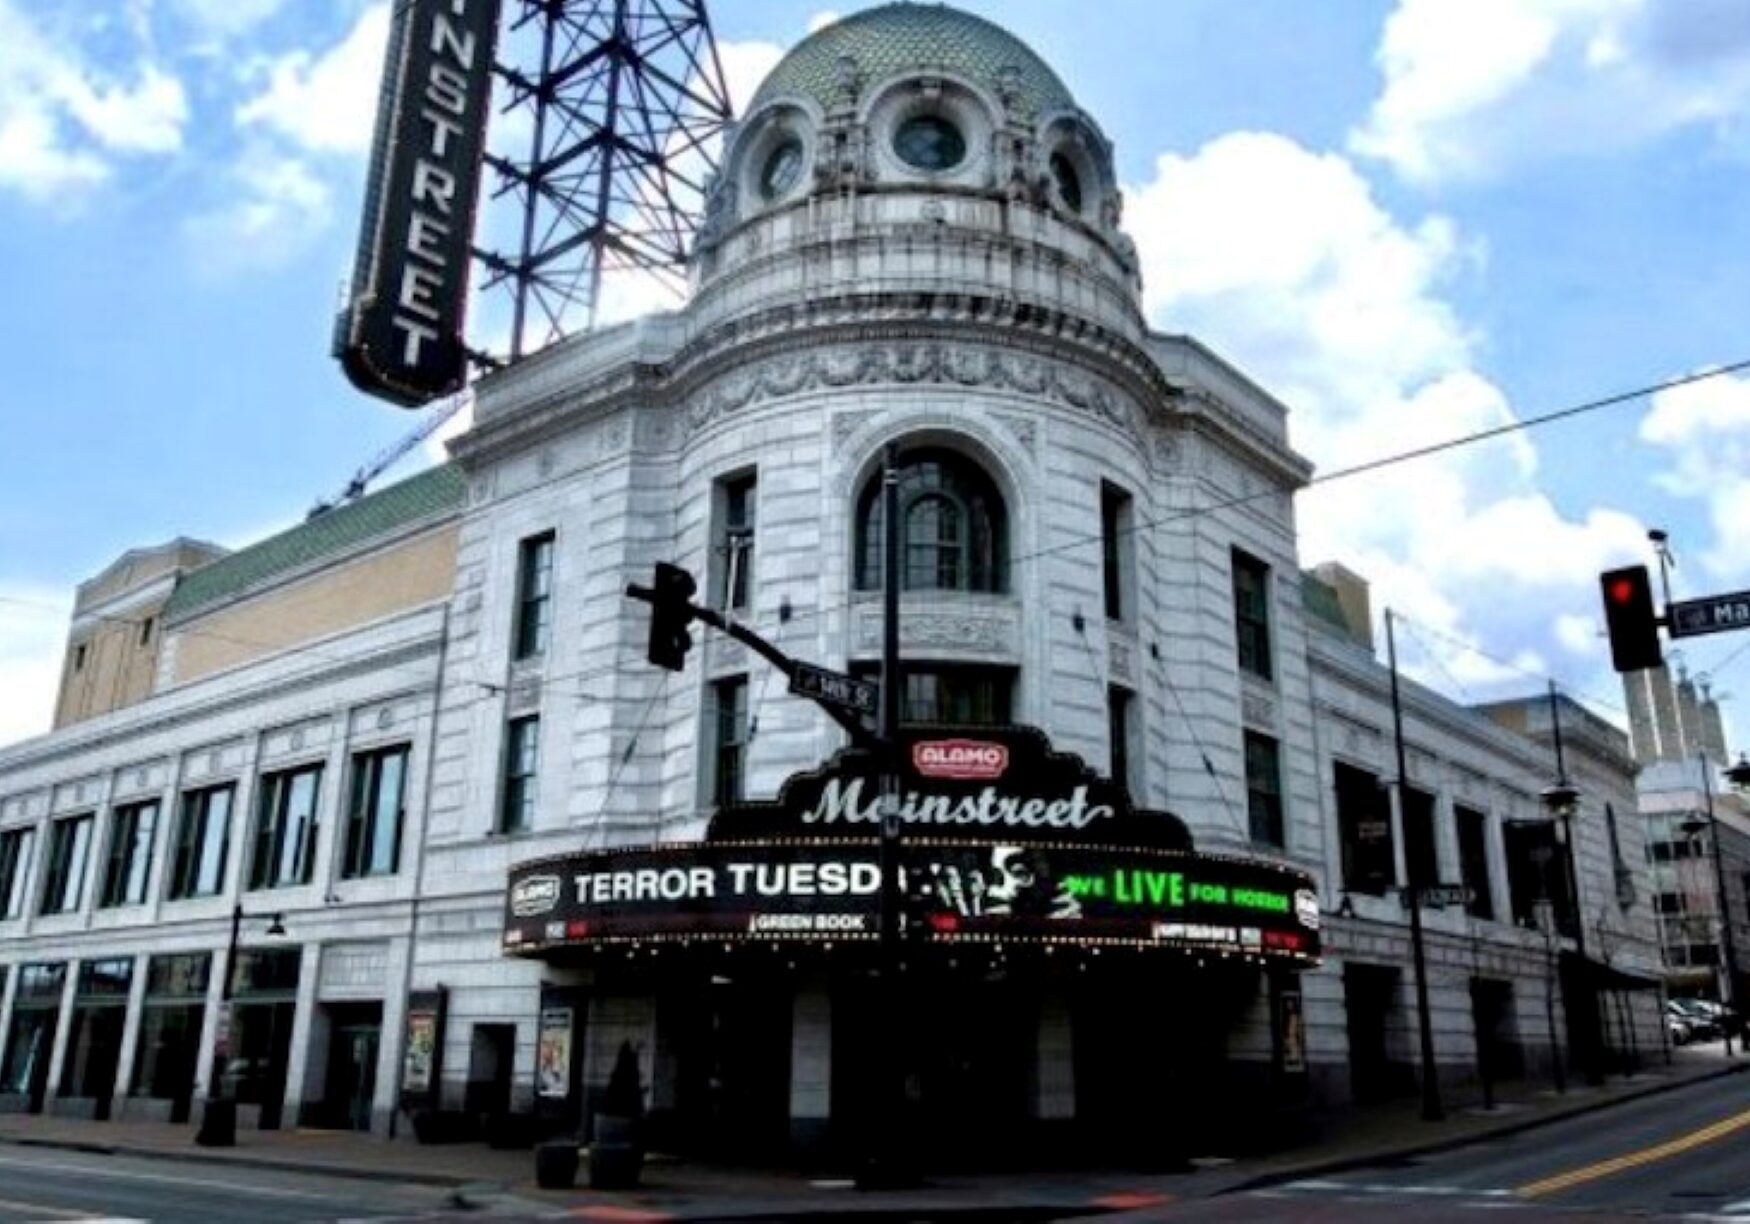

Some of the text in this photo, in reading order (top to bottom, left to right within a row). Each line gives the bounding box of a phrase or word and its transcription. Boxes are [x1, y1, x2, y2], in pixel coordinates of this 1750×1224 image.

[921, 746, 1001, 766] ALAMO
[574, 866, 716, 903] TERROR
[727, 861, 907, 896] TUESD
[1115, 869, 1184, 907] LIVE
[1189, 882, 1227, 904] FOR
[755, 912, 866, 931] GREEN BOOK
